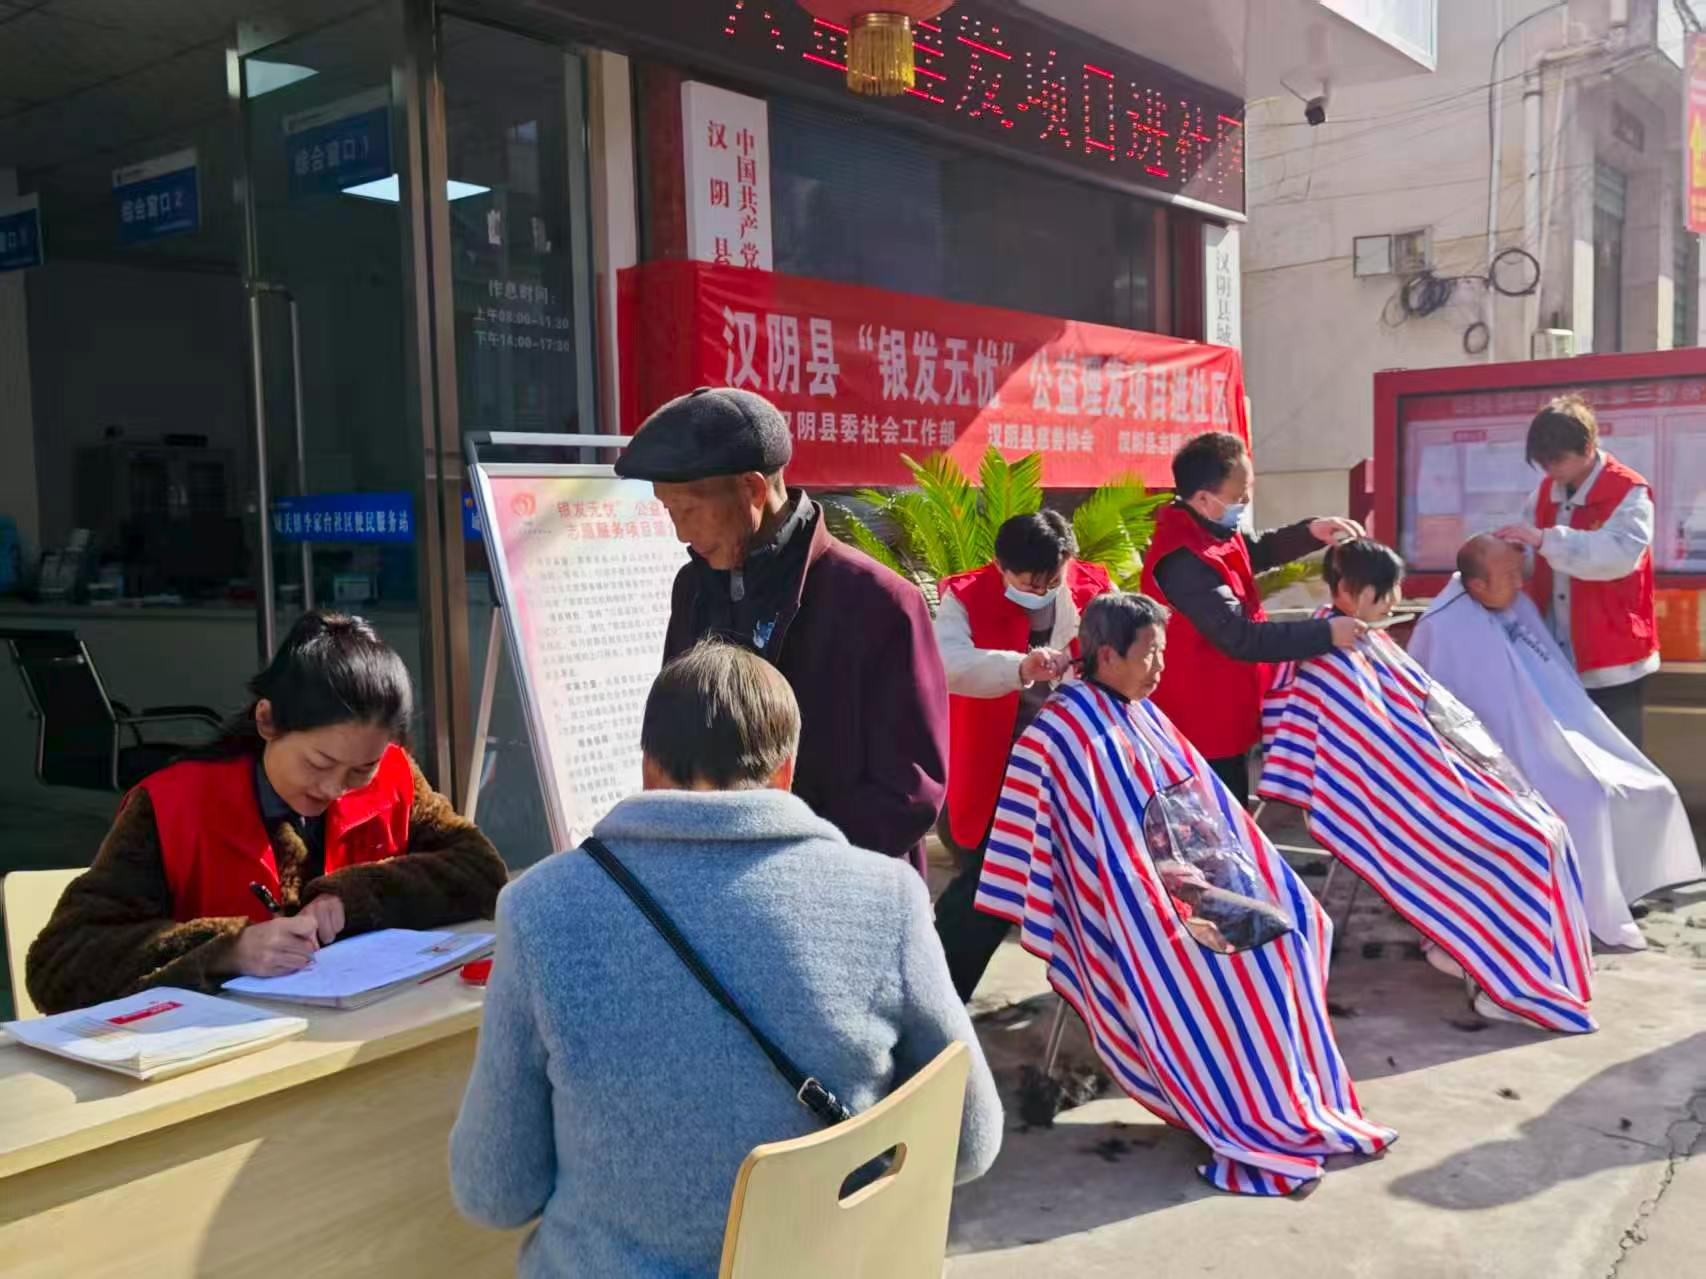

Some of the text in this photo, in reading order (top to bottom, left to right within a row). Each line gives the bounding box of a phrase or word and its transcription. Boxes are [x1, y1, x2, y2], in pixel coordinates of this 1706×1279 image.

[707, 120, 732, 265] 汉阴县
[736, 127, 760, 271] 中国共产党
